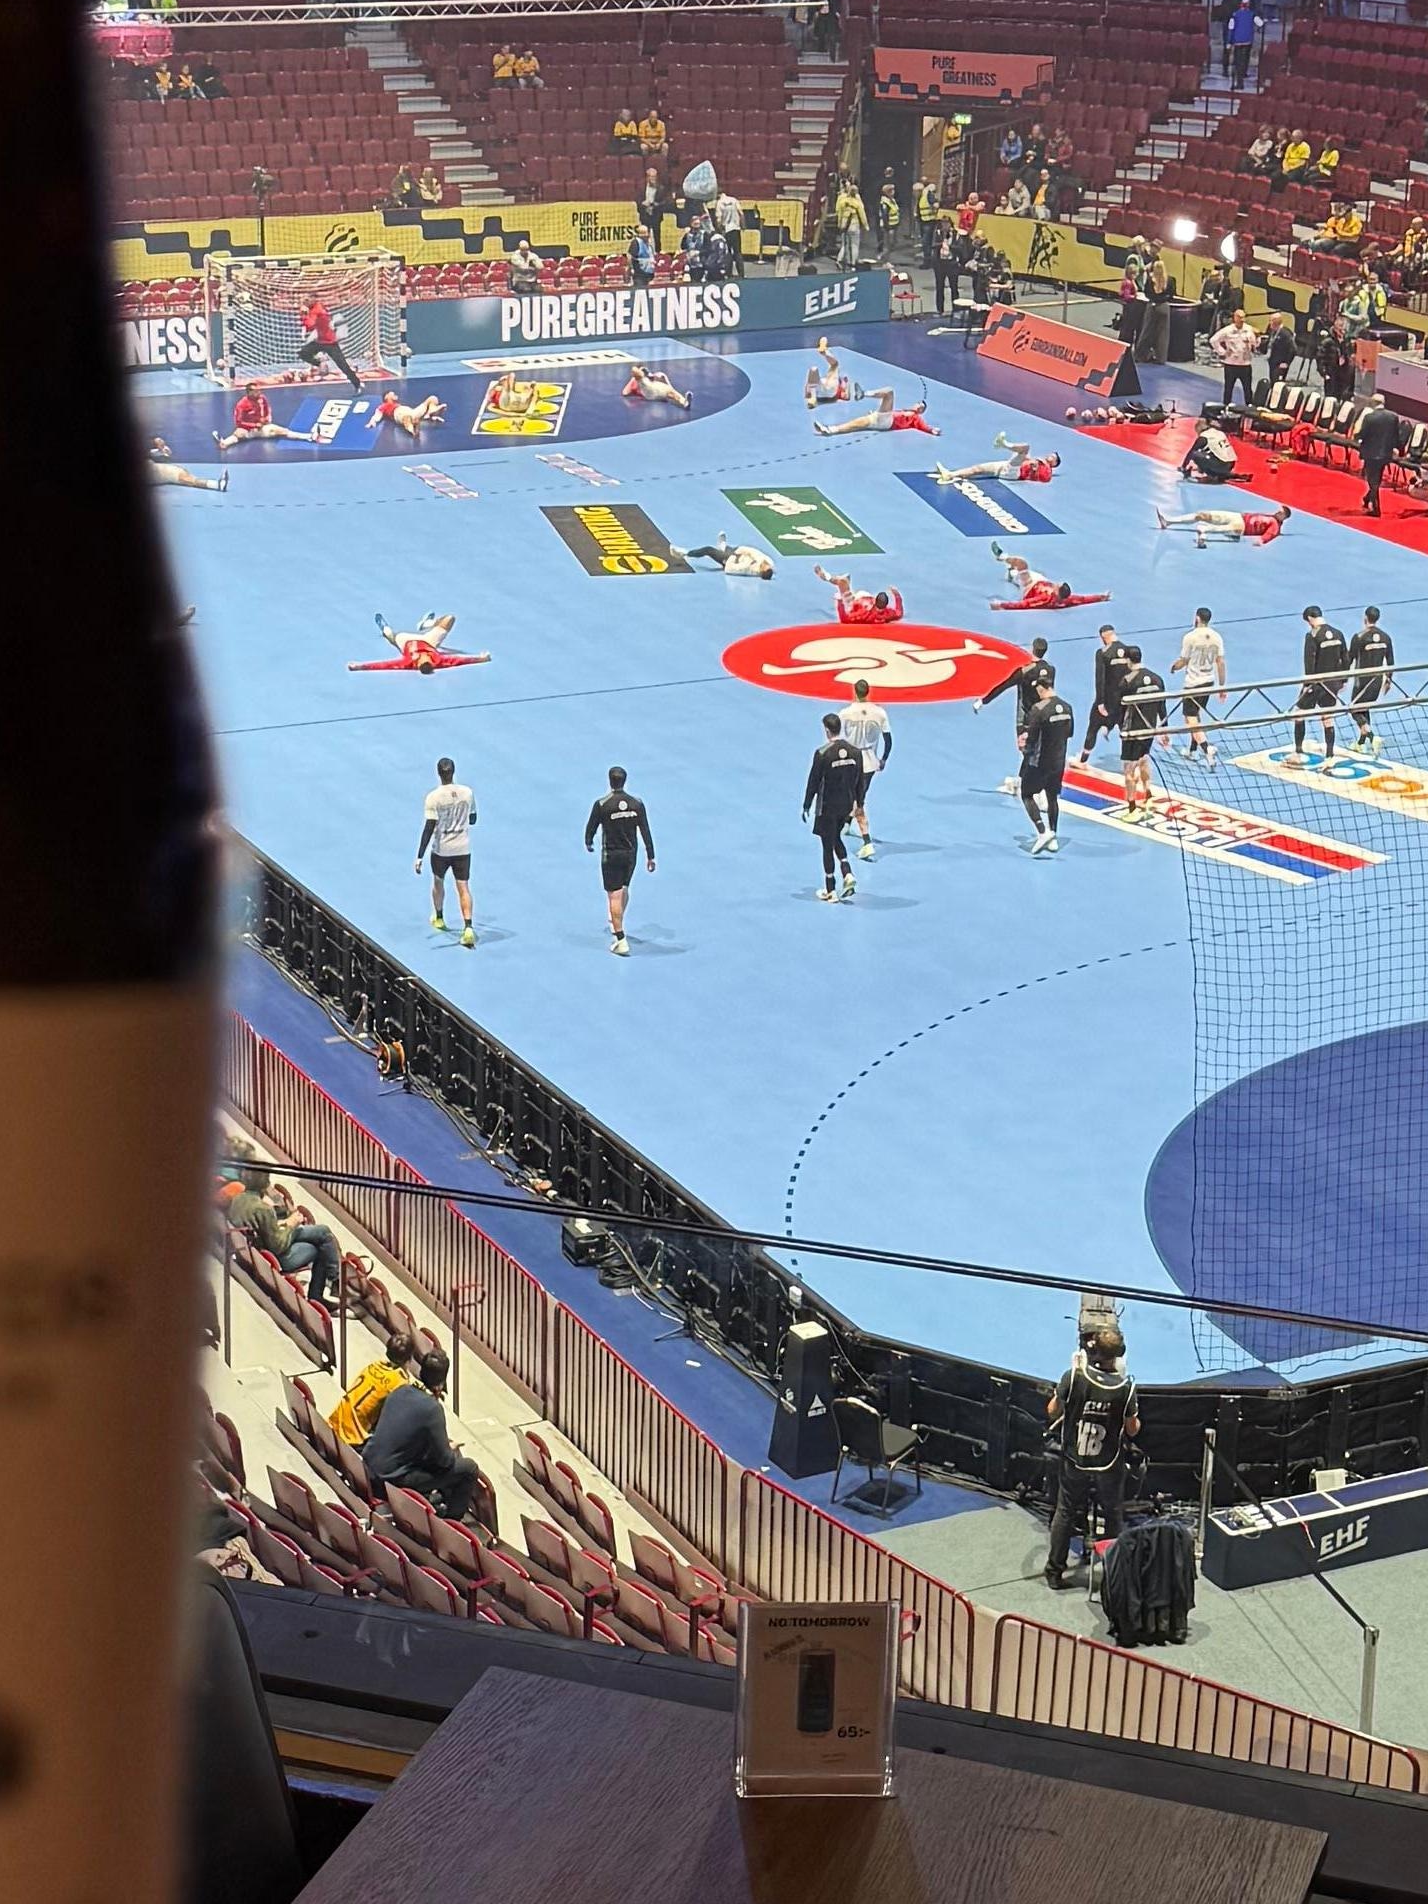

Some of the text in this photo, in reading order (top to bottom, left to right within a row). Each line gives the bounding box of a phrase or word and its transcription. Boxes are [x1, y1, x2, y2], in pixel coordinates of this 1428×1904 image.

[932, 55, 957, 70] PURE
[942, 70, 997, 87] GREATNESS
[572, 210, 599, 227] PURE
[803, 276, 859, 317] EHF
[501, 282, 741, 342] PUREGREATNESS
[1319, 1514, 1371, 1555] EHF
[790, 1616, 871, 1628] TOMORROW
